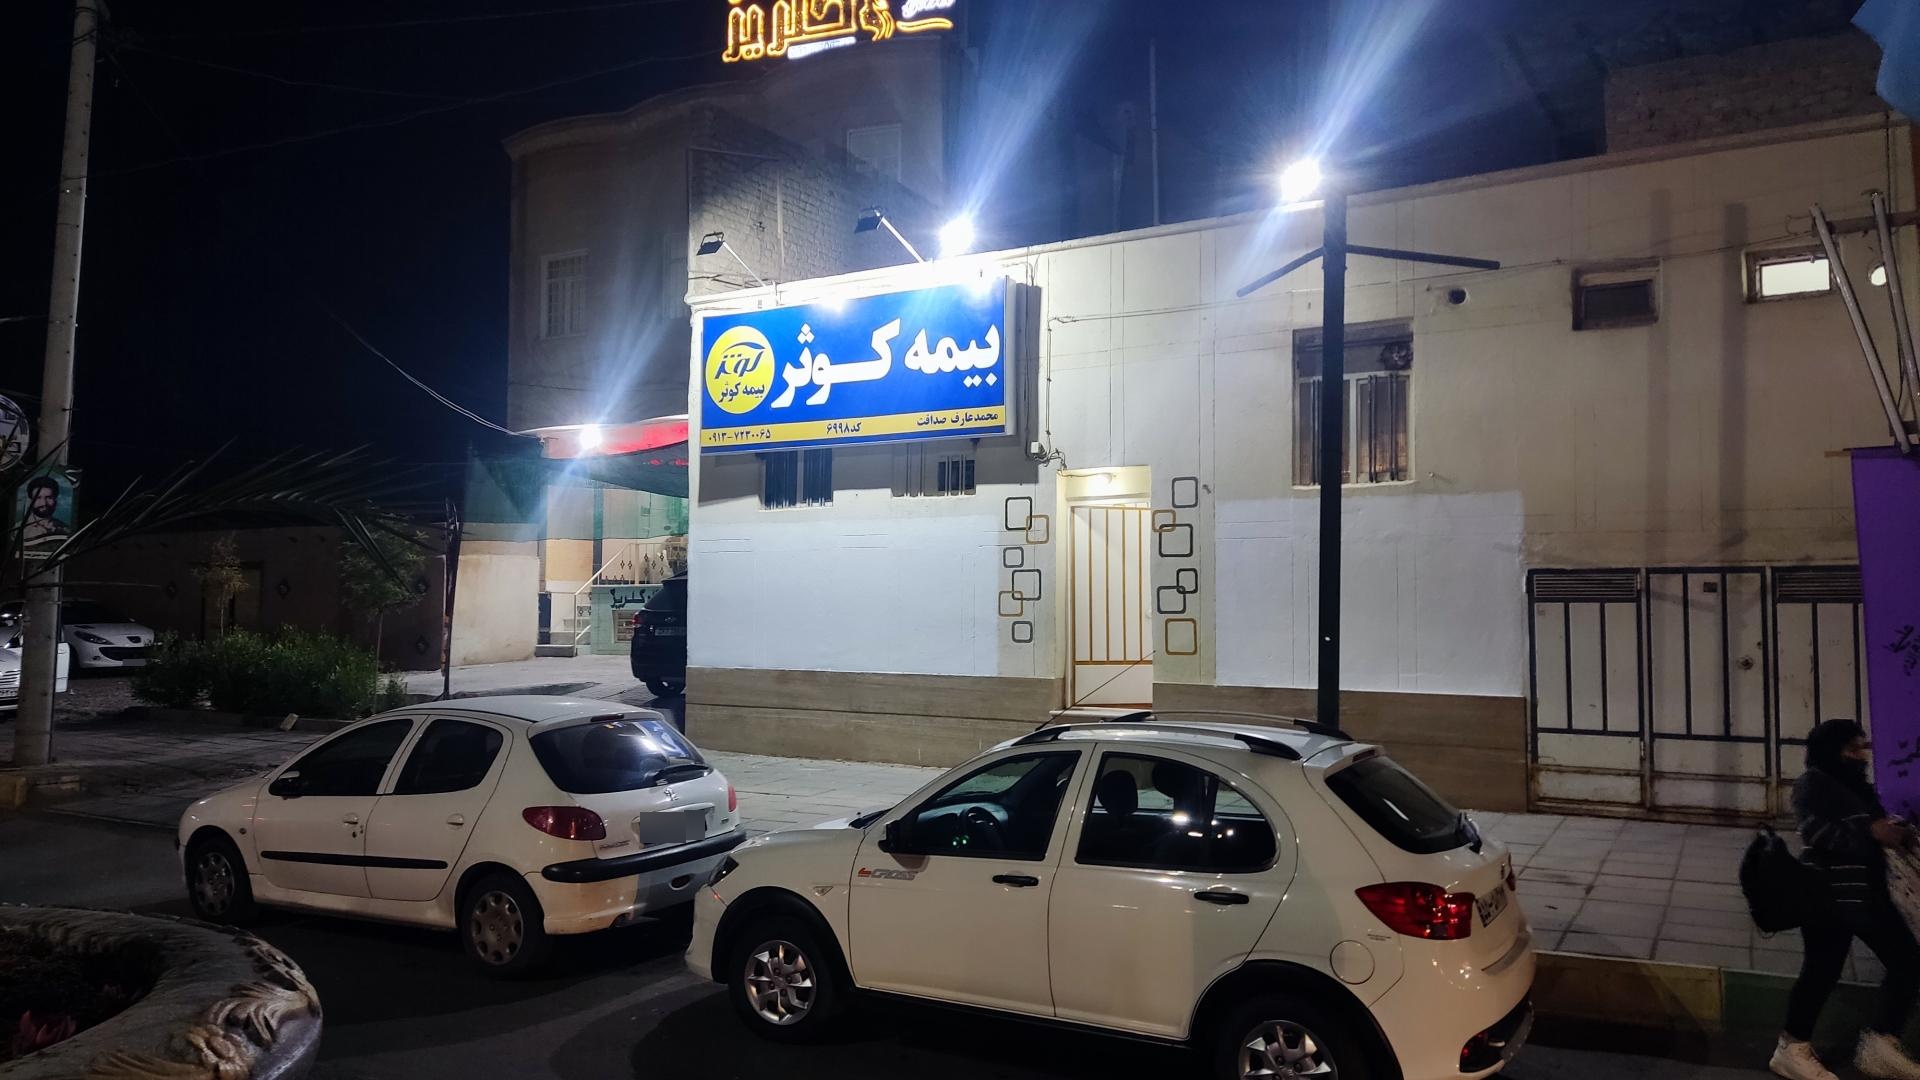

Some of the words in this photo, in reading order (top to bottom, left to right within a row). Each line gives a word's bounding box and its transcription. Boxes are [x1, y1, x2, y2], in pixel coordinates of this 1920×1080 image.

[770, 318, 901, 409] کوثر
[904, 324, 1000, 388] بیمه
[718, 381, 741, 403] کوثر
[742, 383, 765, 399] بیمه
[916, 414, 947, 427] صداقت
